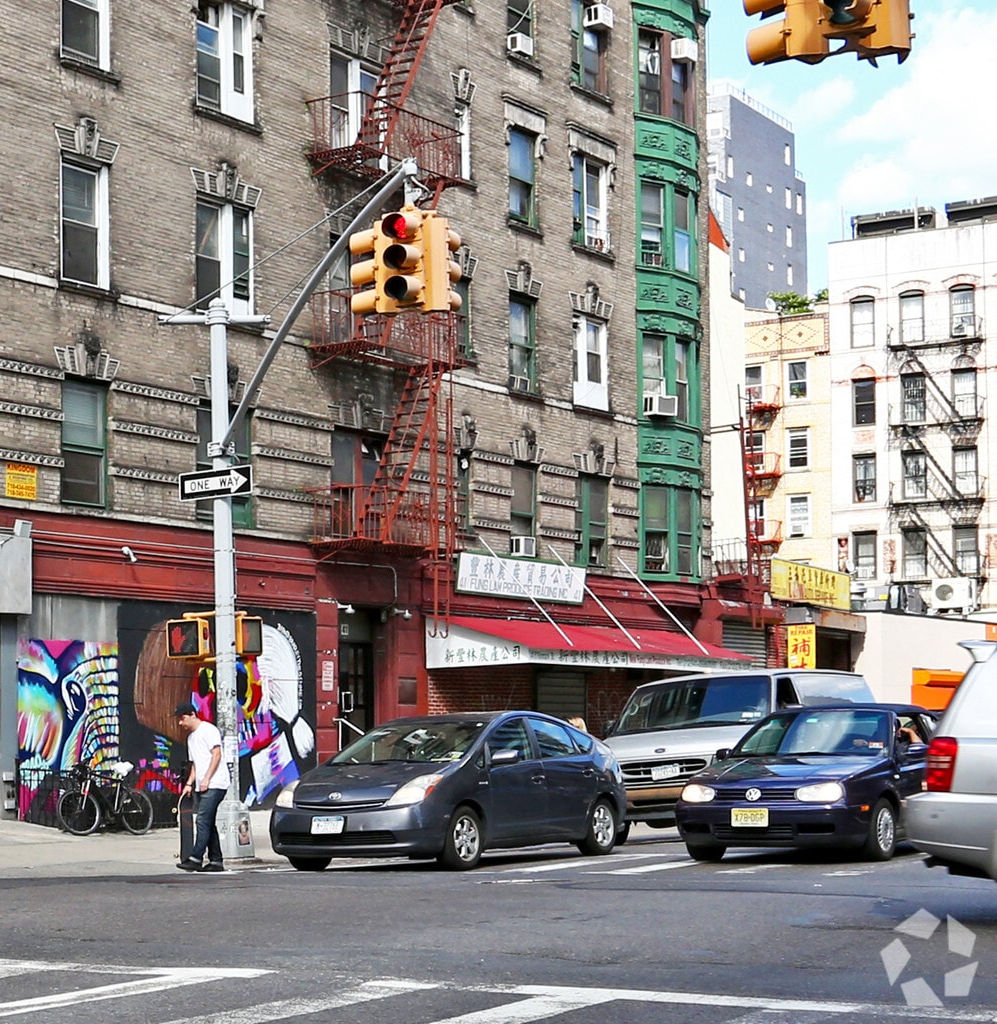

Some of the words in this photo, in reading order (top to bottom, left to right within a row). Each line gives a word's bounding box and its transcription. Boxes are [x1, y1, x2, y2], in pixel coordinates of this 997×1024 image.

[190, 479, 210, 492] ONE
[218, 476, 240, 487] WAY
[470, 578, 489, 591] FUNG
[489, 580, 502, 592] LAM
[503, 582, 532, 596] PRODUCE
[533, 585, 558, 598] TRADING
